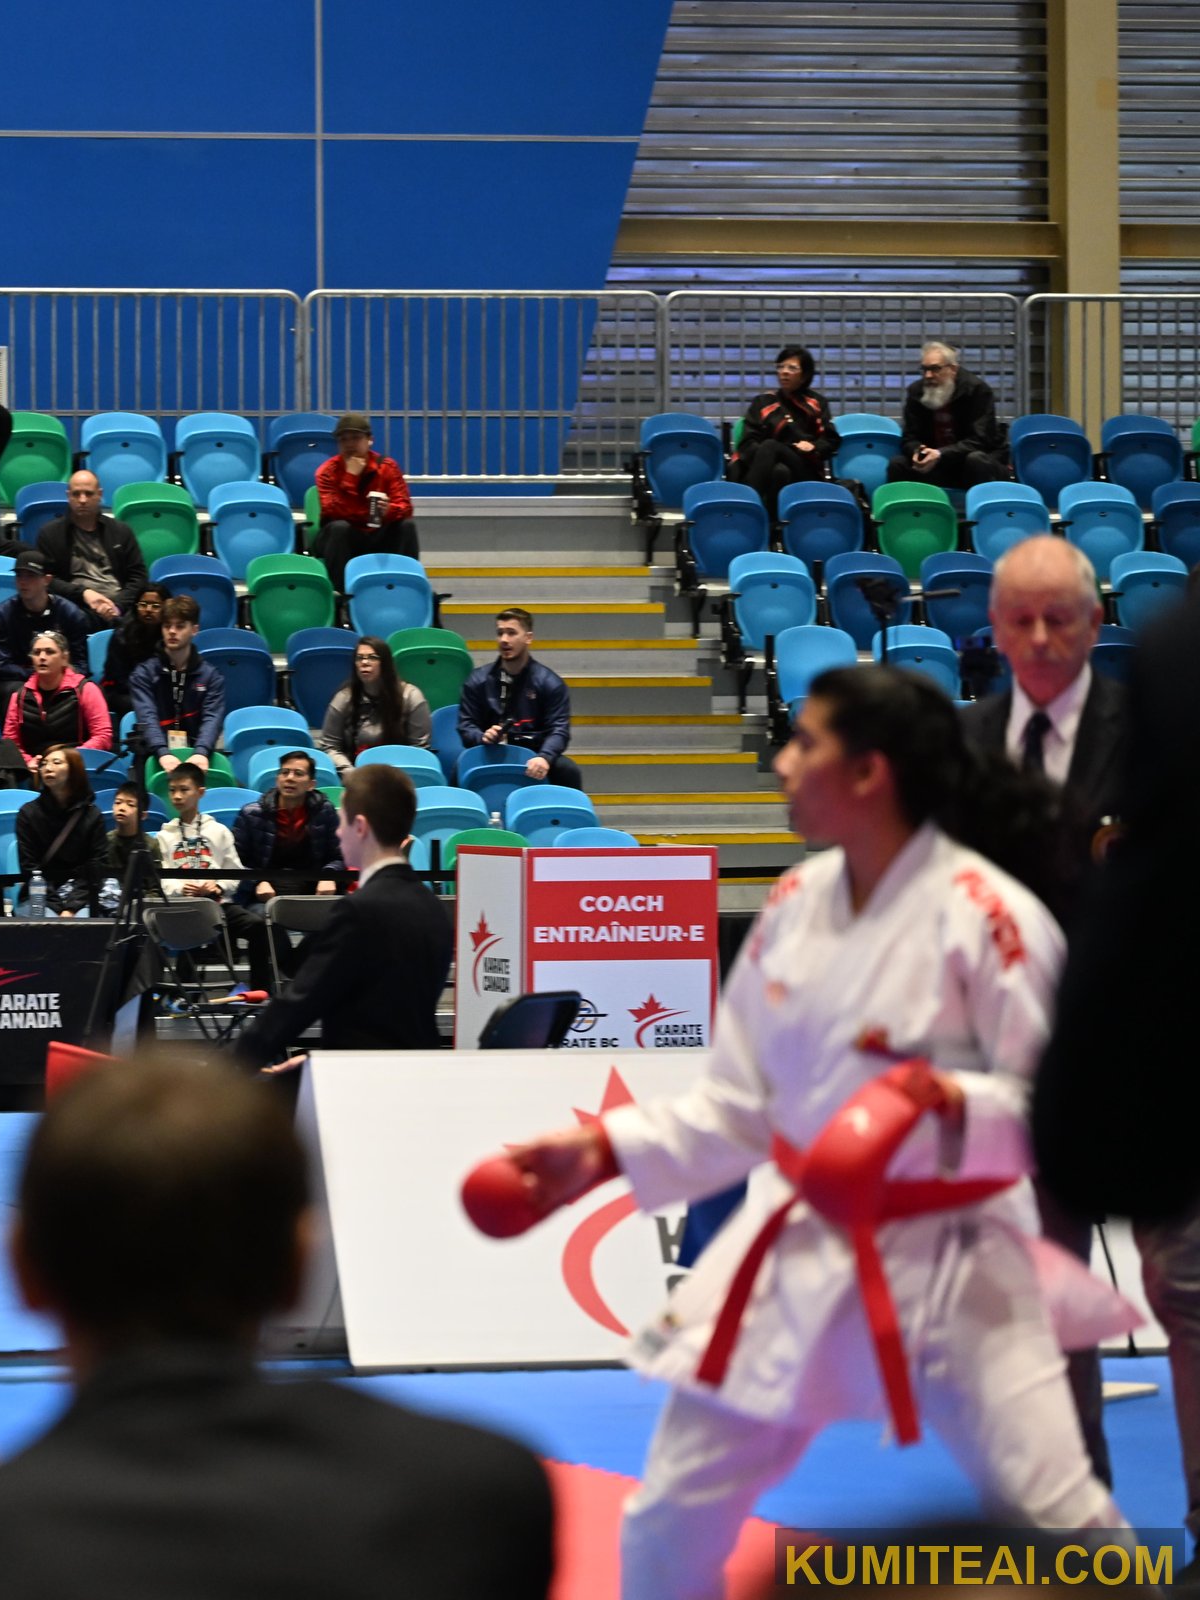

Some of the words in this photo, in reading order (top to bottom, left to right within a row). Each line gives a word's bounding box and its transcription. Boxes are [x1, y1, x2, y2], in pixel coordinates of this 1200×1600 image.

[579, 895, 664, 912] COACH
[533, 921, 705, 943] ENTRAÎNEUR·E
[654, 1024, 703, 1036] KARATE
[562, 1037, 597, 1048] RATE
[600, 1037, 619, 1048] BC
[654, 1036, 704, 1048] CANADA
